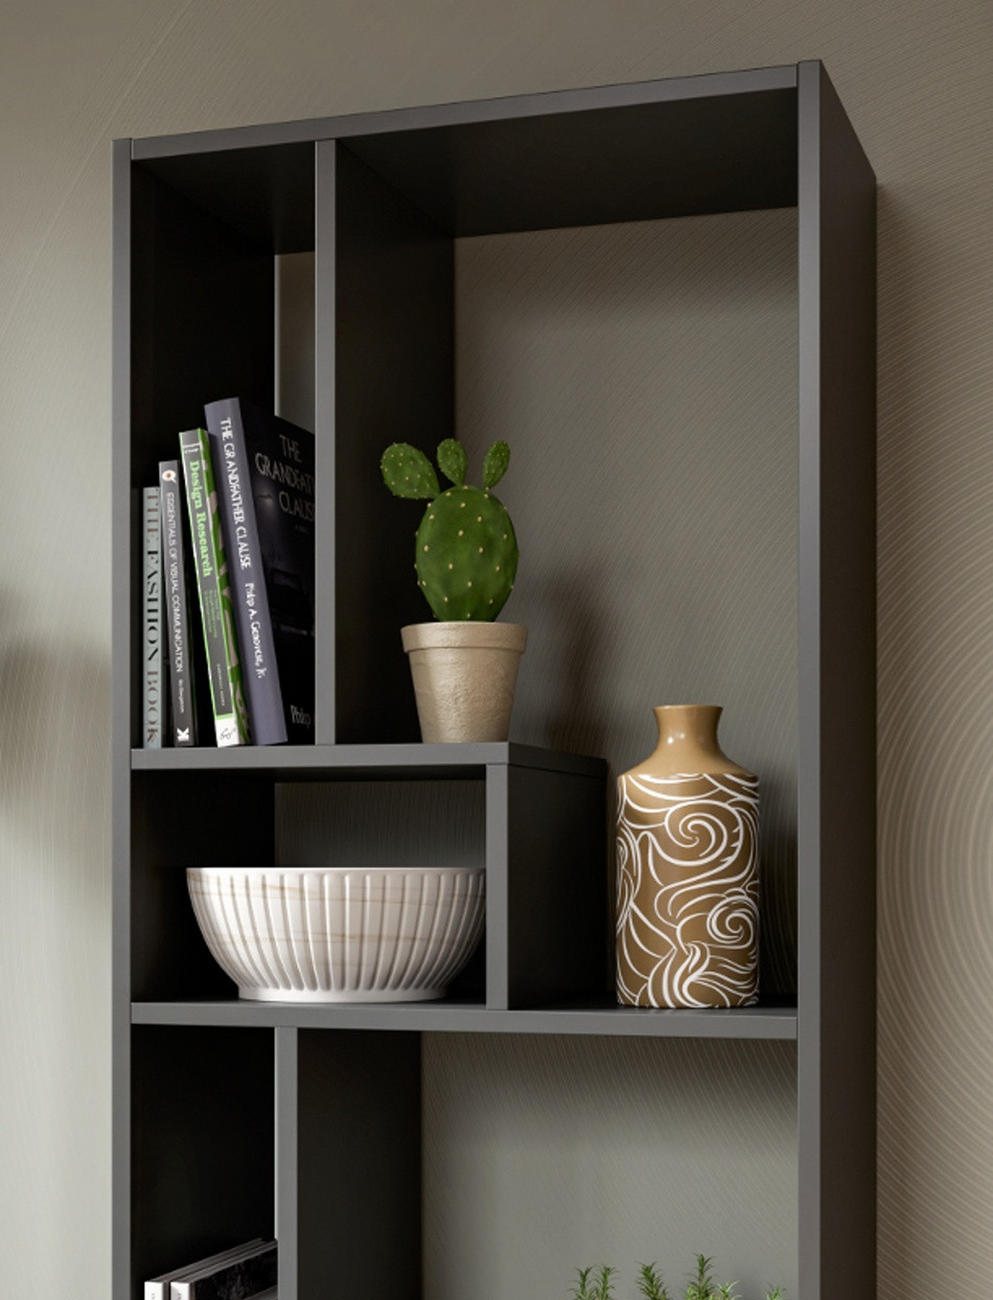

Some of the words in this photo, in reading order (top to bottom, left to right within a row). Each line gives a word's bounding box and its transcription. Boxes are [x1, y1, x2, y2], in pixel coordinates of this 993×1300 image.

[220, 416, 233, 440] THE
[279, 433, 303, 464] THE
[224, 442, 245, 525] GRANDFATHER
[254, 452, 315, 495] GRANDFAT
[190, 461, 203, 508] Design
[197, 511, 213, 577] Research
[279, 490, 315, 521] CLAUS
[169, 547, 178, 561] OF
[236, 526, 252, 570] CLAUSE
[170, 562, 180, 594] VISUAL
[147, 550, 160, 662] FASHION
[172, 594, 184, 673] COMMUNICATION
[146, 671, 160, 743] BOOK
